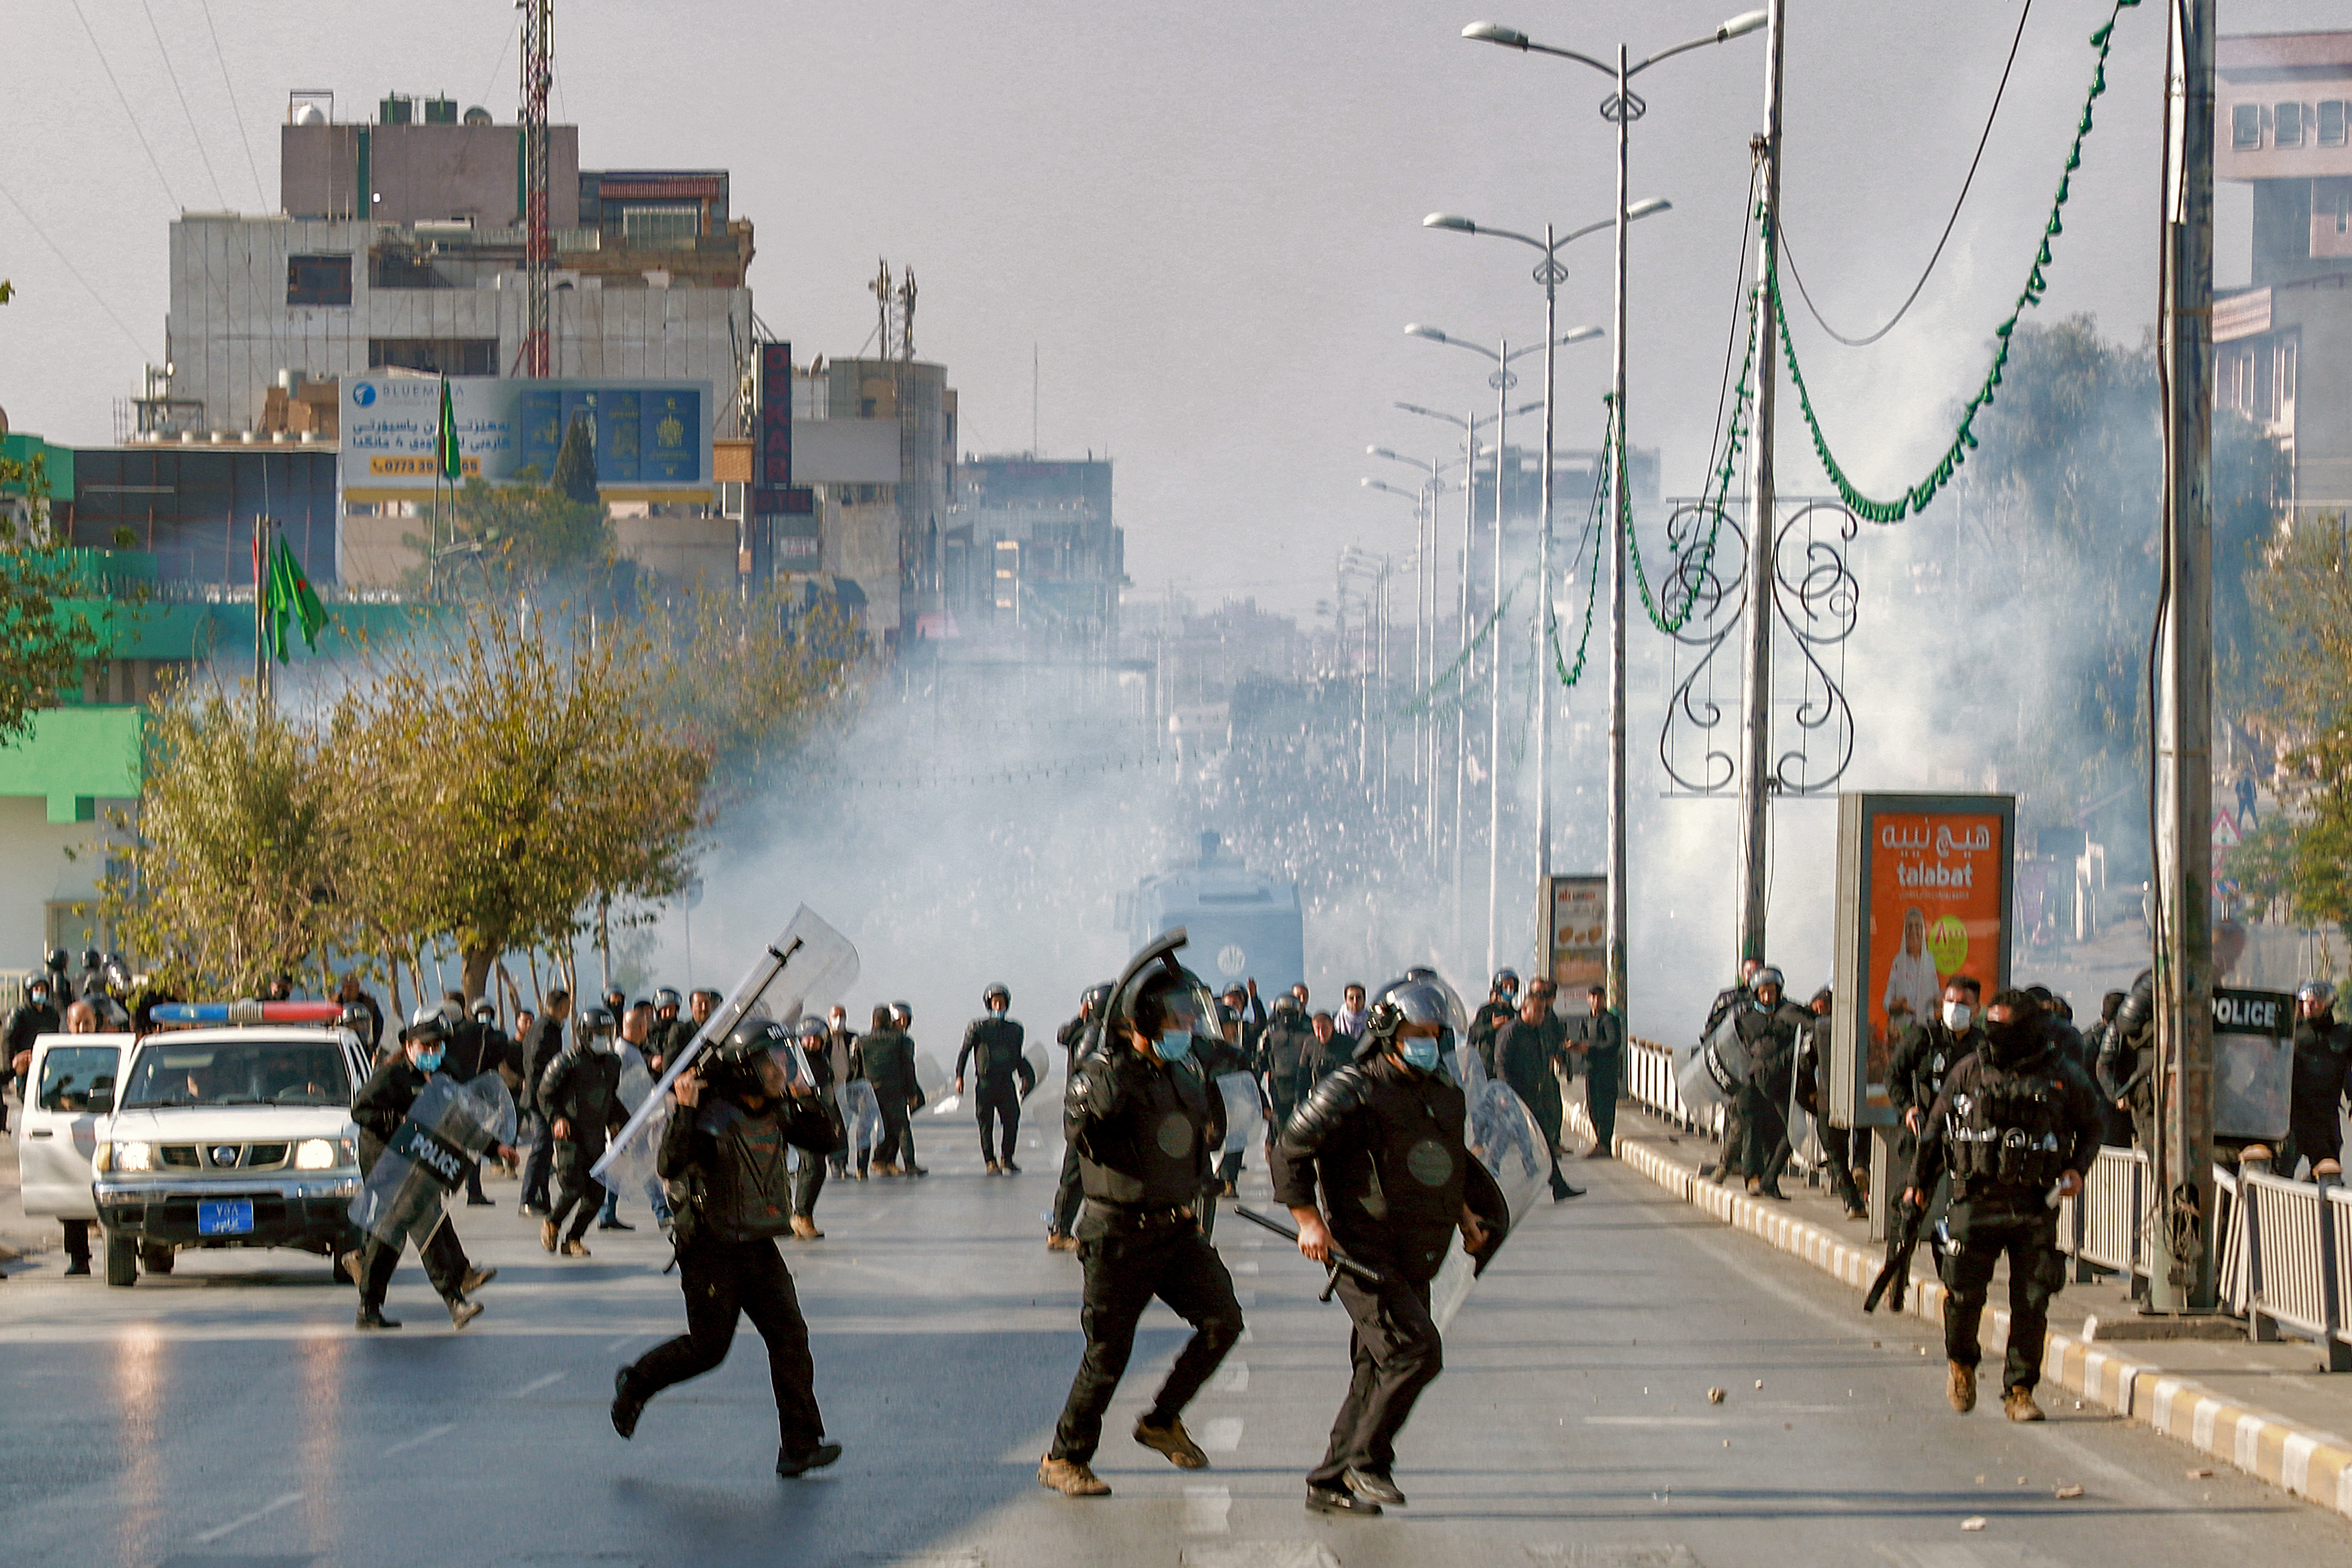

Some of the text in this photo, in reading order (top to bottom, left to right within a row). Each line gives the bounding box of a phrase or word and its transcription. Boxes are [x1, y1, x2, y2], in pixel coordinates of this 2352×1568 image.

[383, 384, 464, 397] BLUEMIA
[765, 346, 789, 482] OSKAR
[1896, 860, 1974, 888] talabat
[1707, 1040, 1731, 1090] POLICE
[410, 1132, 461, 1181] POLICE
